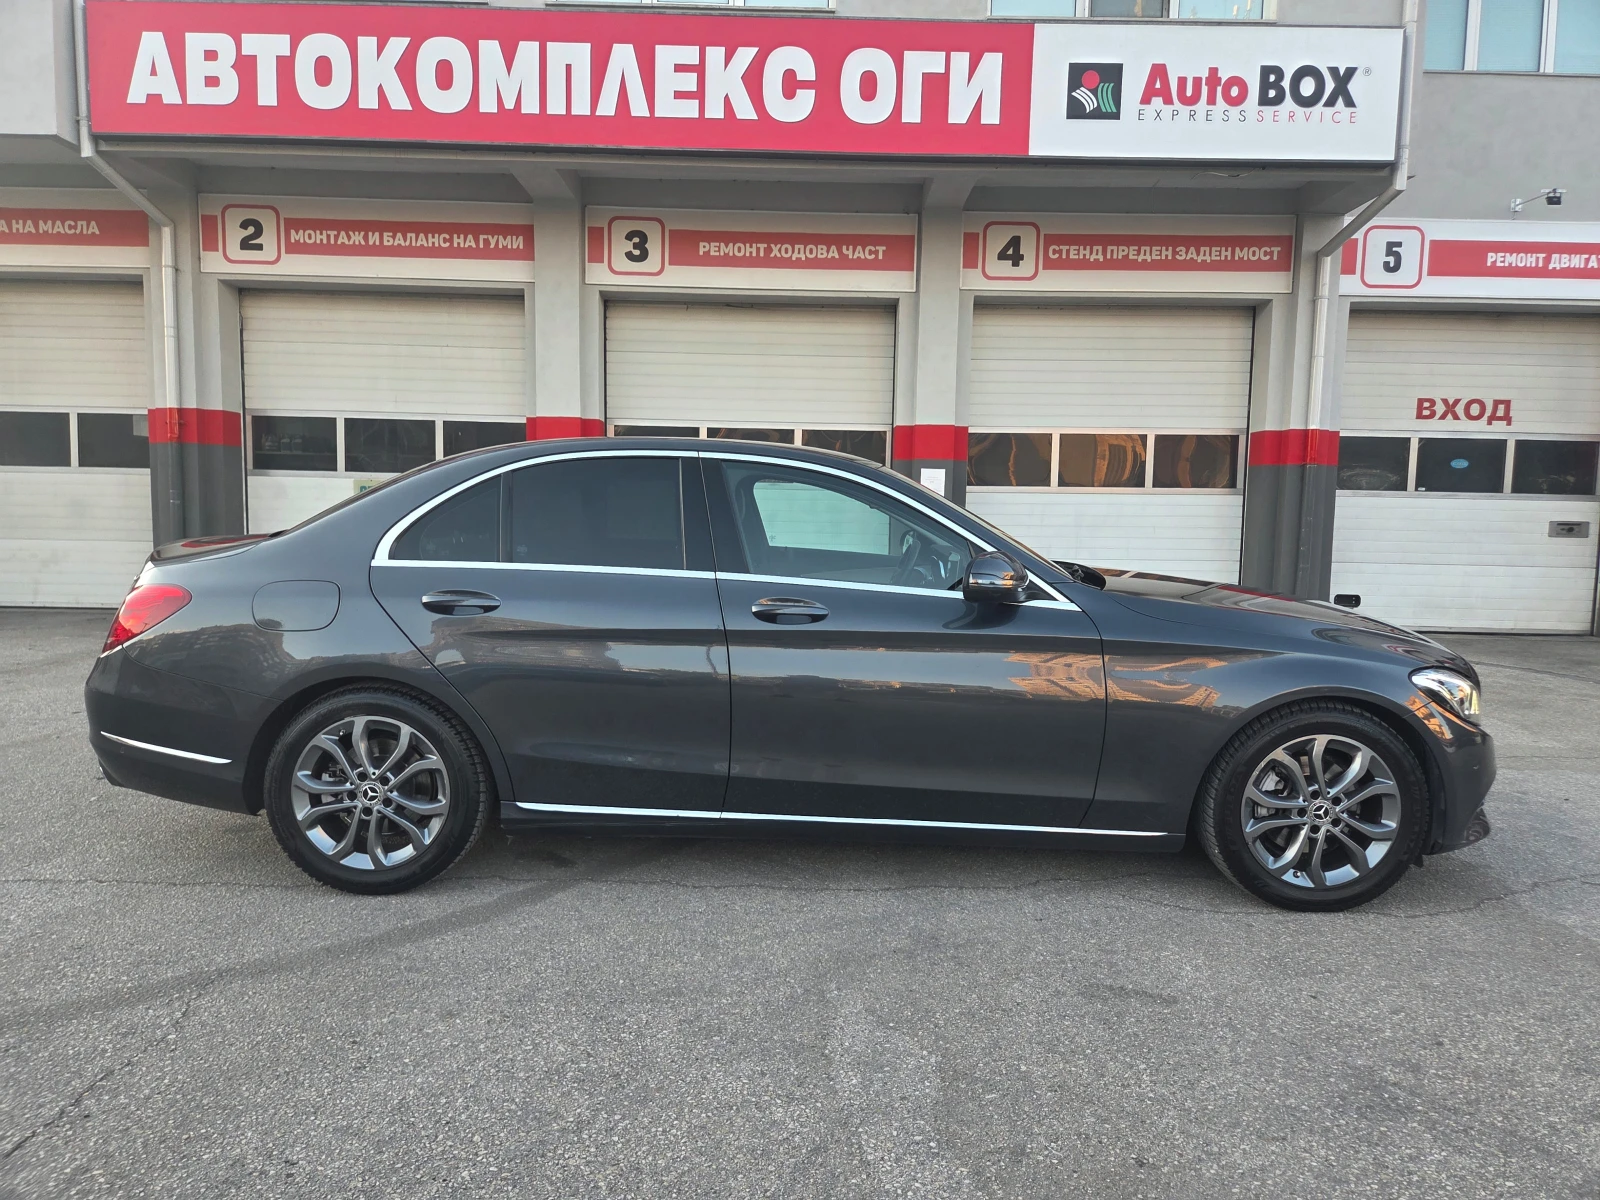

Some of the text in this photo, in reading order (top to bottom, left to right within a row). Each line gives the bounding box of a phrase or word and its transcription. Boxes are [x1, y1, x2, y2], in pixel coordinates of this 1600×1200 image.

[126, 31, 1003, 125] АВТОКОМПЛЕКС ОГИ
[1139, 63, 1359, 108] Auto BOX
[1138, 108, 1358, 124] EXPRESS SERVICE
[12, 219, 36, 233] НА
[38, 219, 100, 235] МАСЛА
[238, 217, 264, 252] 2
[290, 229, 524, 249] МОНТАЖ И БАЛАНС НА ГУМИ
[624, 229, 650, 263] 3
[699, 241, 887, 261] РЕМОНТ ХОДОВА ЧАСТ
[997, 235, 1025, 267] 4
[1048, 245, 1282, 263] СТЕНД ПРЕДЕН ЗАДЕН МОСТ
[1382, 241, 1403, 274] 5
[1486, 252, 1600, 270] РЕМОНТ ДВИГА
[1415, 397, 1513, 426] ВХОД
